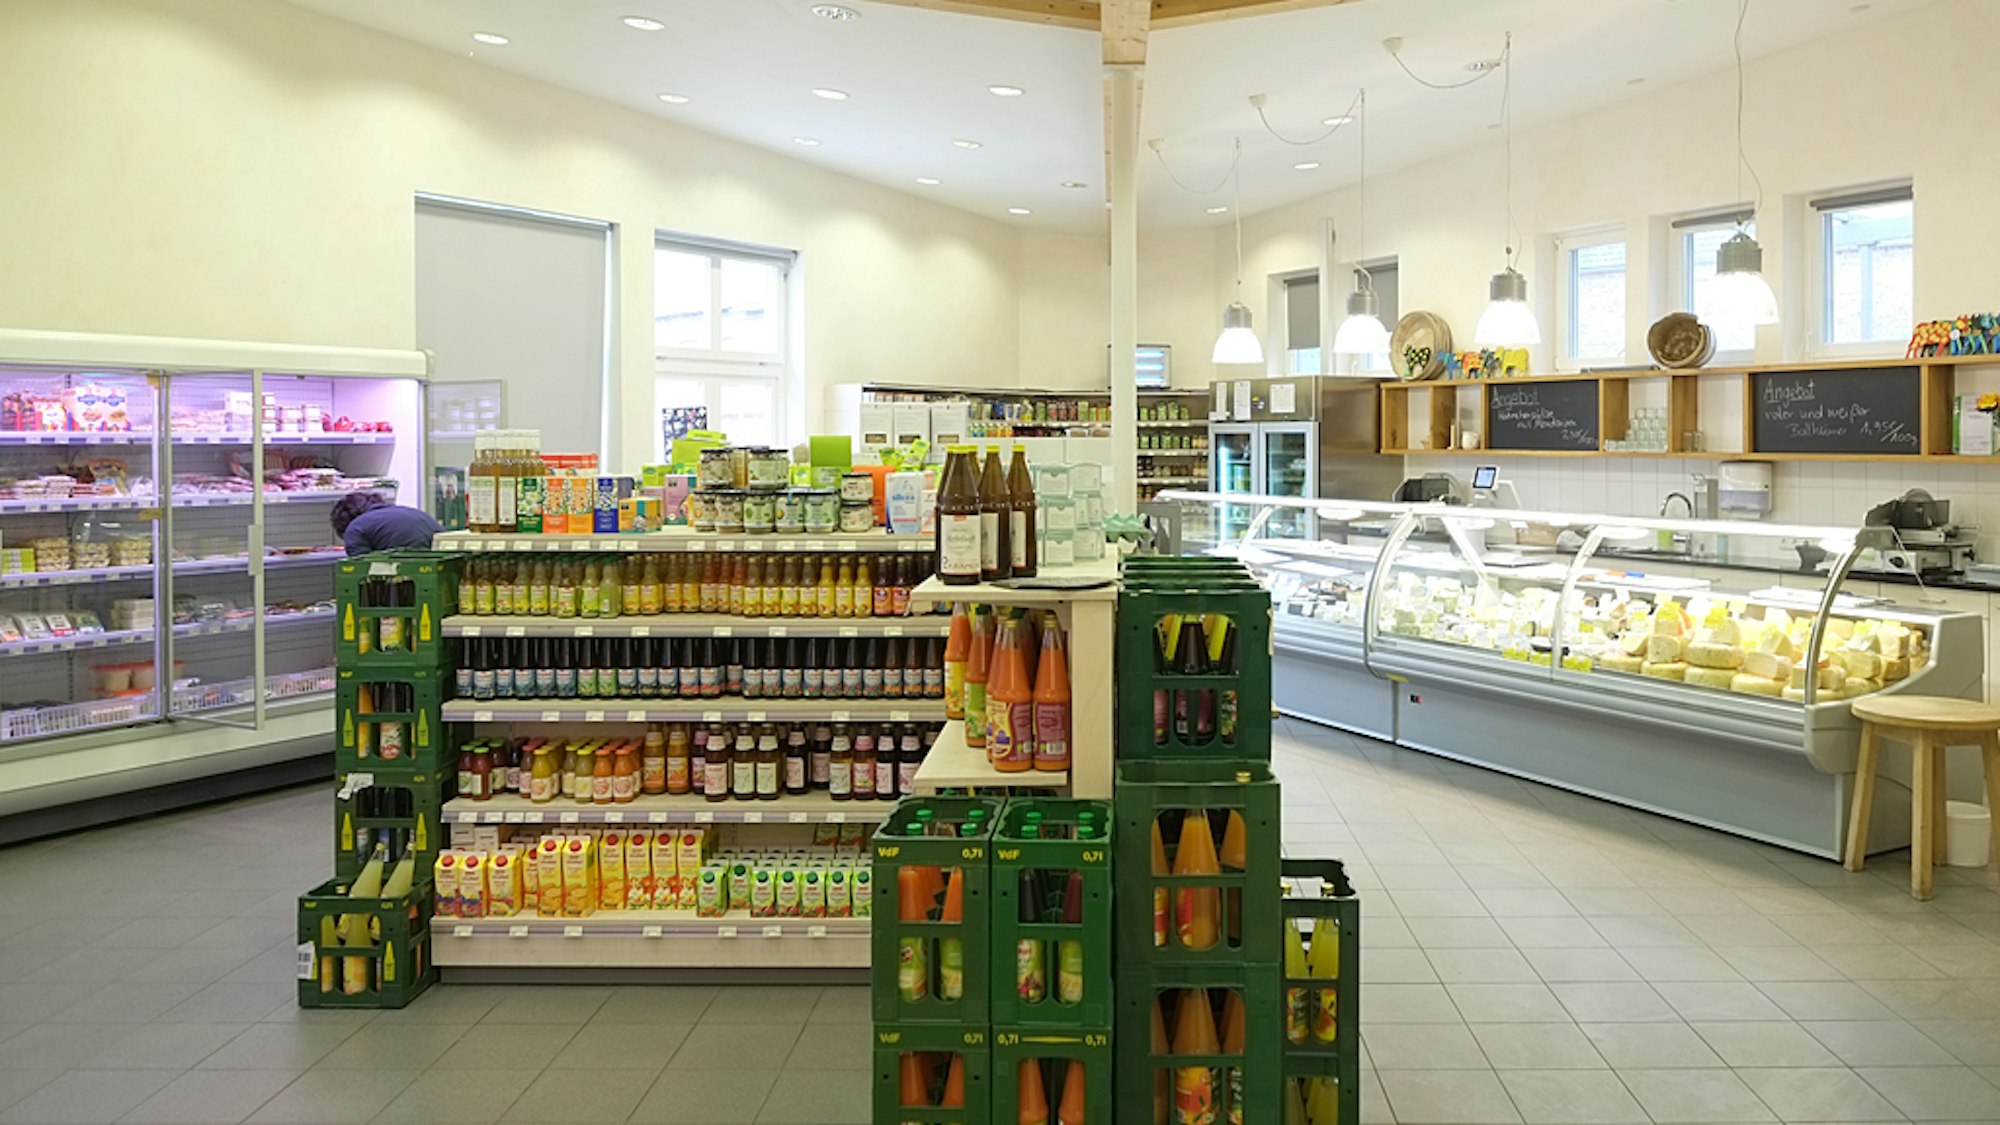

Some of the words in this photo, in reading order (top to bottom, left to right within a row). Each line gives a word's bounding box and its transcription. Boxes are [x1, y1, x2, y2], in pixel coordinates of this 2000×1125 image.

[1490, 385, 1540, 410] Angebot
[1764, 378, 1816, 408] Angebot
[1800, 404, 1824, 420] und
